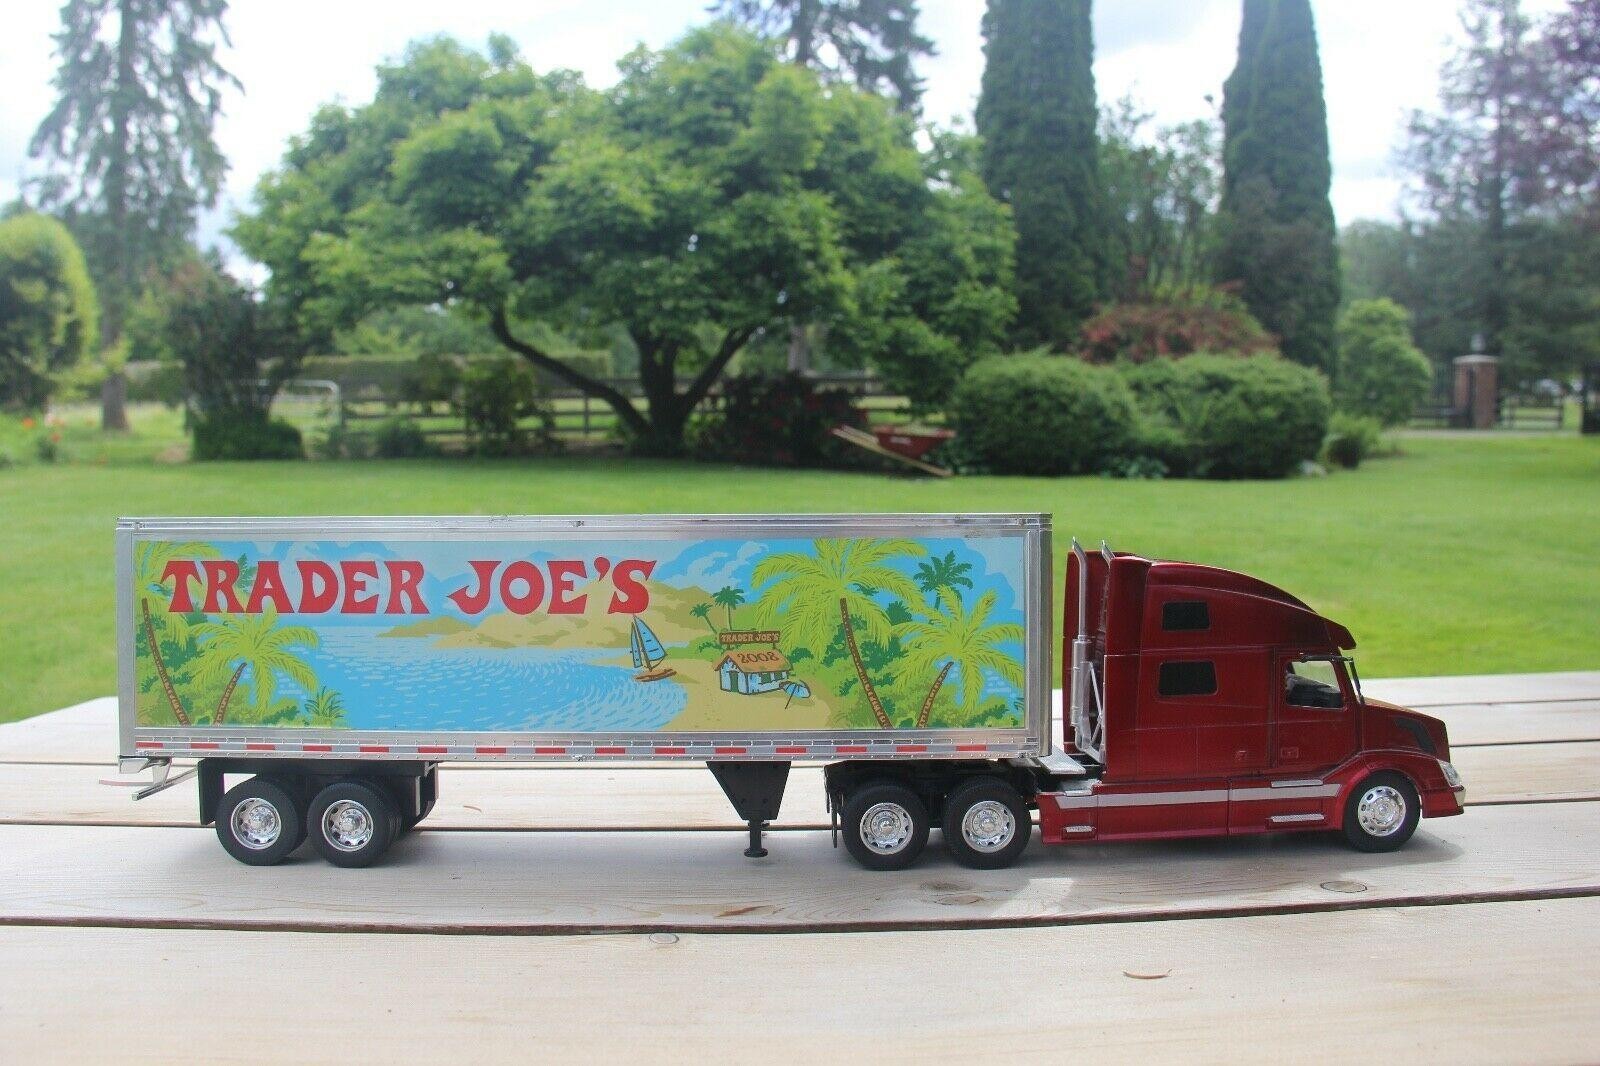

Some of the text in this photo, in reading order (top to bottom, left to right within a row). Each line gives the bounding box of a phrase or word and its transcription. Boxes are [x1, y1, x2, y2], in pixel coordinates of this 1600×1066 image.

[160, 556, 658, 615] TRADER JOE'S
[720, 632, 779, 642] TRADER JOE'S
[737, 651, 780, 664] 2008
